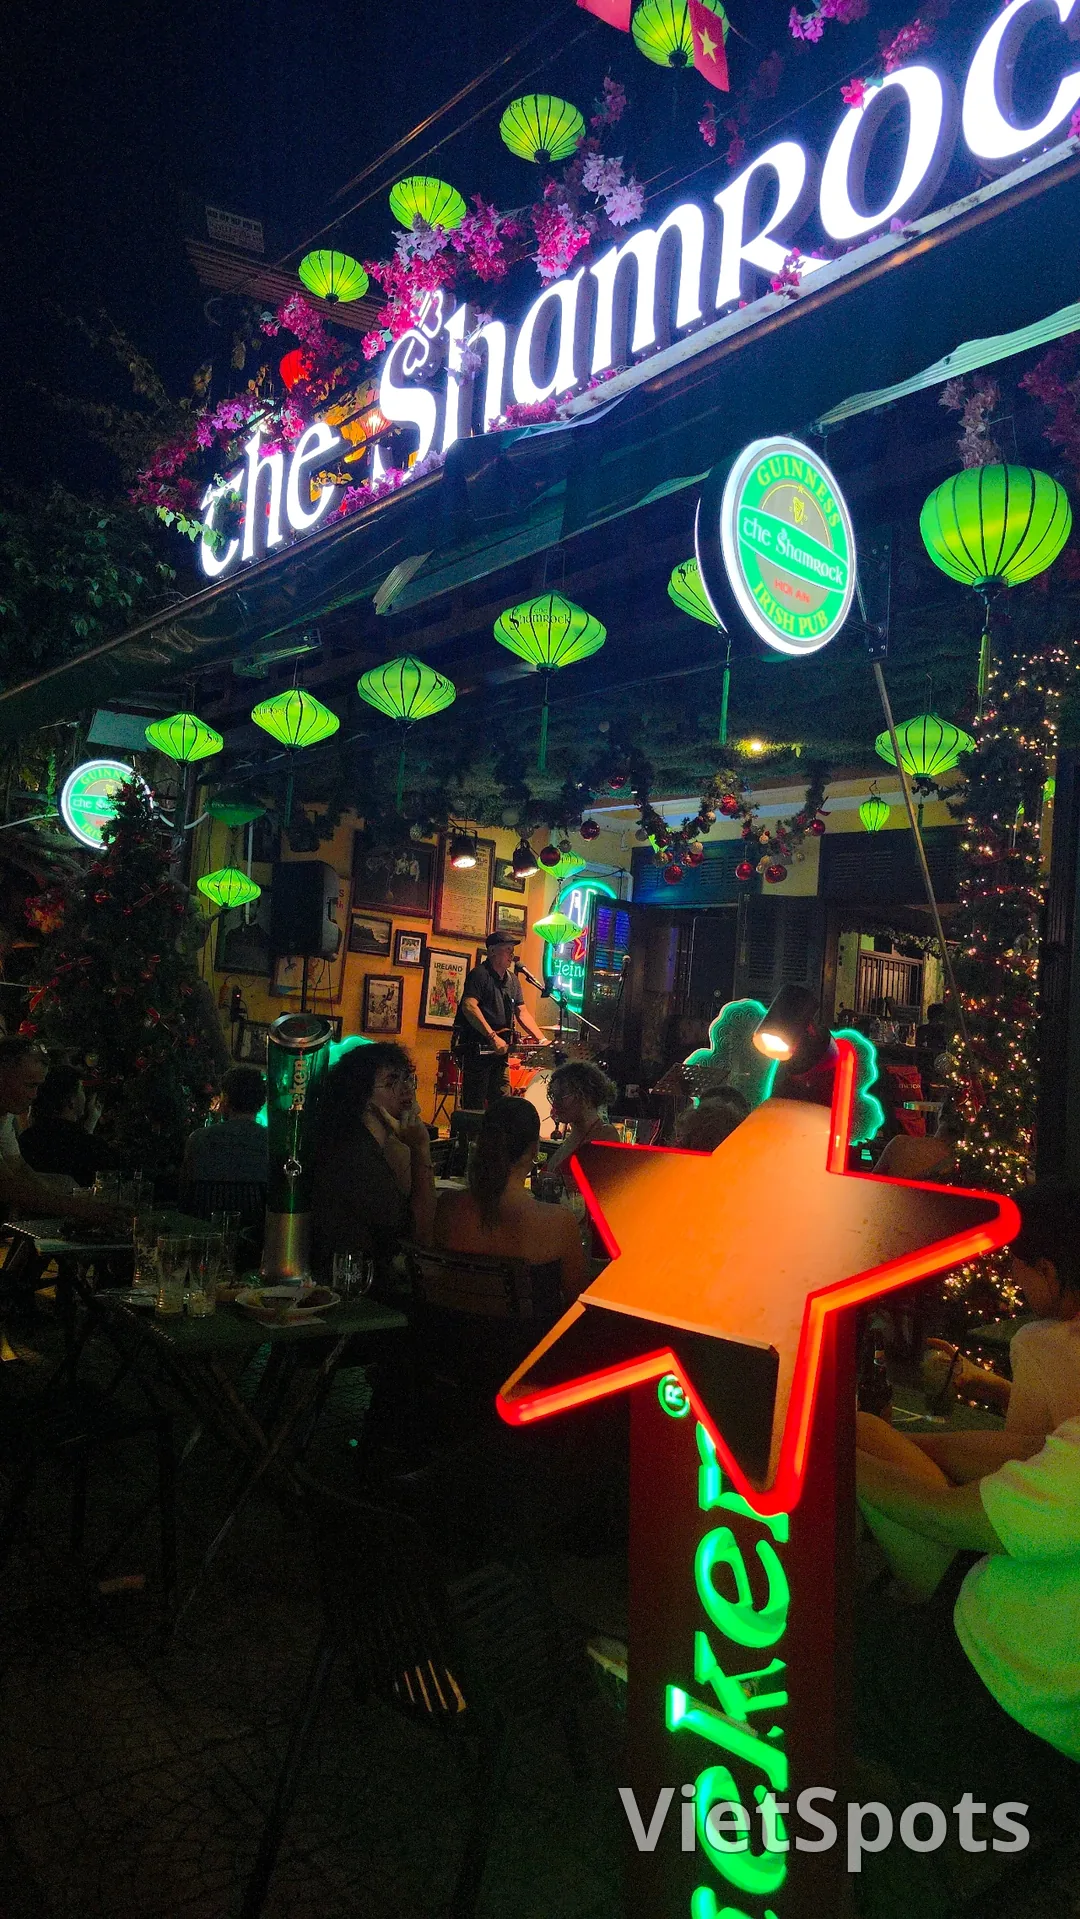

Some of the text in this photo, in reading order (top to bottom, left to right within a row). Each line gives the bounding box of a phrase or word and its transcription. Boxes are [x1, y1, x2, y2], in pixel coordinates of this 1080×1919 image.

[200, 422, 340, 577] the
[757, 455, 842, 528] GUINNESS
[743, 516, 772, 547] the
[753, 581, 829, 636] IRISH PUB
[795, 589, 810, 604] AN
[434, 962, 463, 973] IRELAND
